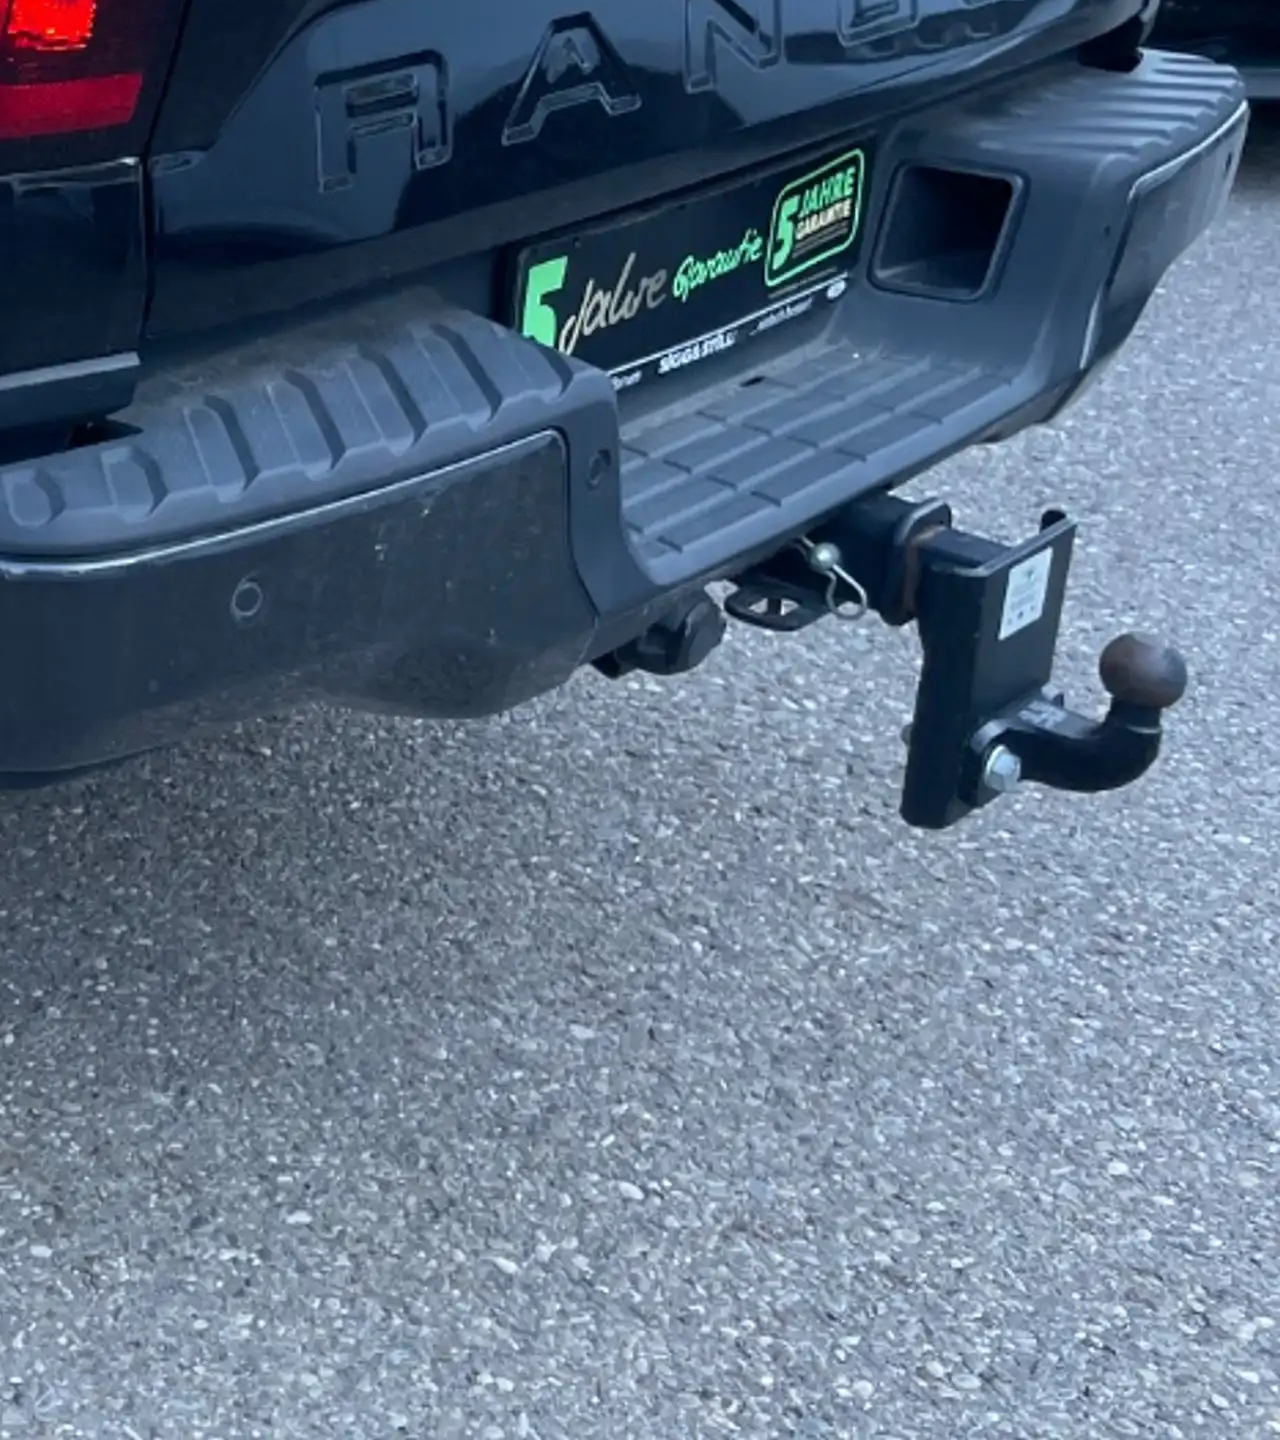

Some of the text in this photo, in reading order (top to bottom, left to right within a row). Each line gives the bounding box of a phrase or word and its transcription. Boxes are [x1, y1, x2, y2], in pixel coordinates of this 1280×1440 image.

[797, 165, 857, 219] JAHRE
[772, 194, 801, 271] 5
[522, 256, 569, 348] 5
[558, 252, 668, 357] Jahre
